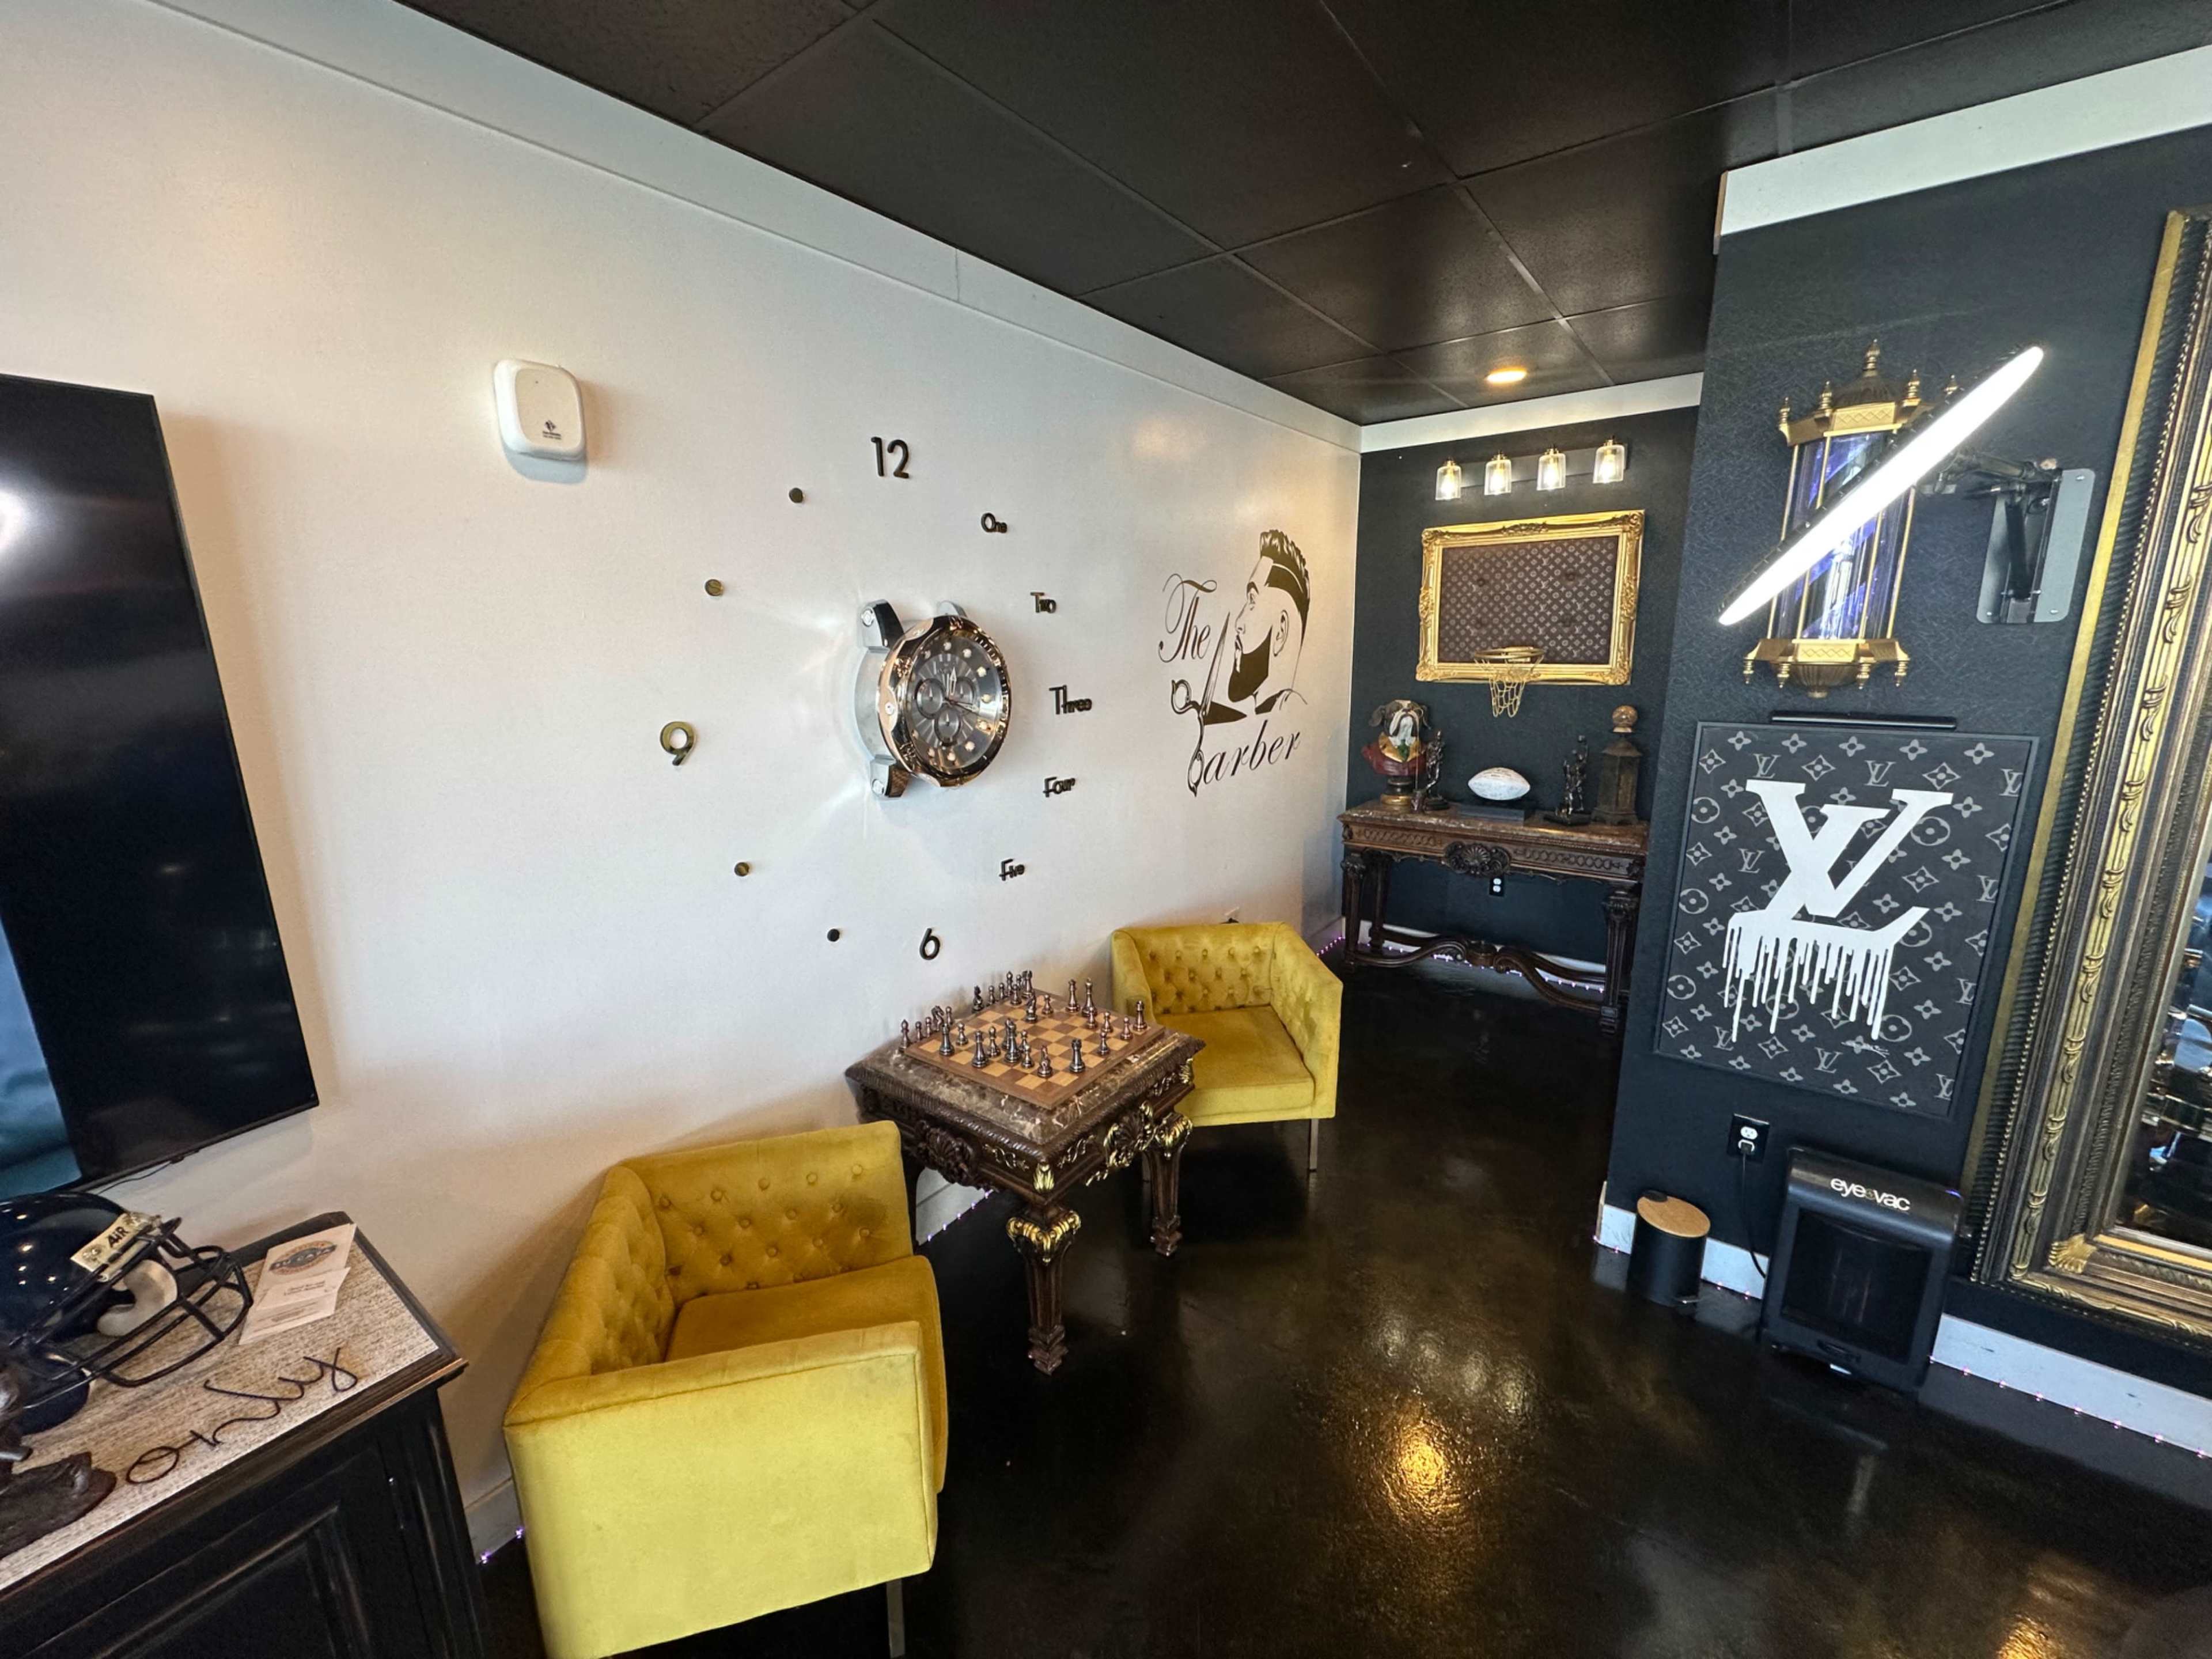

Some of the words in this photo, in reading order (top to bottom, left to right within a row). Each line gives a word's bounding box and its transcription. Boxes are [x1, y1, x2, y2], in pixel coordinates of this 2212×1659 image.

[871, 436, 910, 479] 12
[1158, 573, 1217, 662] The
[1049, 684, 1092, 714] Three
[660, 721, 695, 766] 9
[1043, 777, 1075, 798] Four
[919, 928, 941, 960] 6
